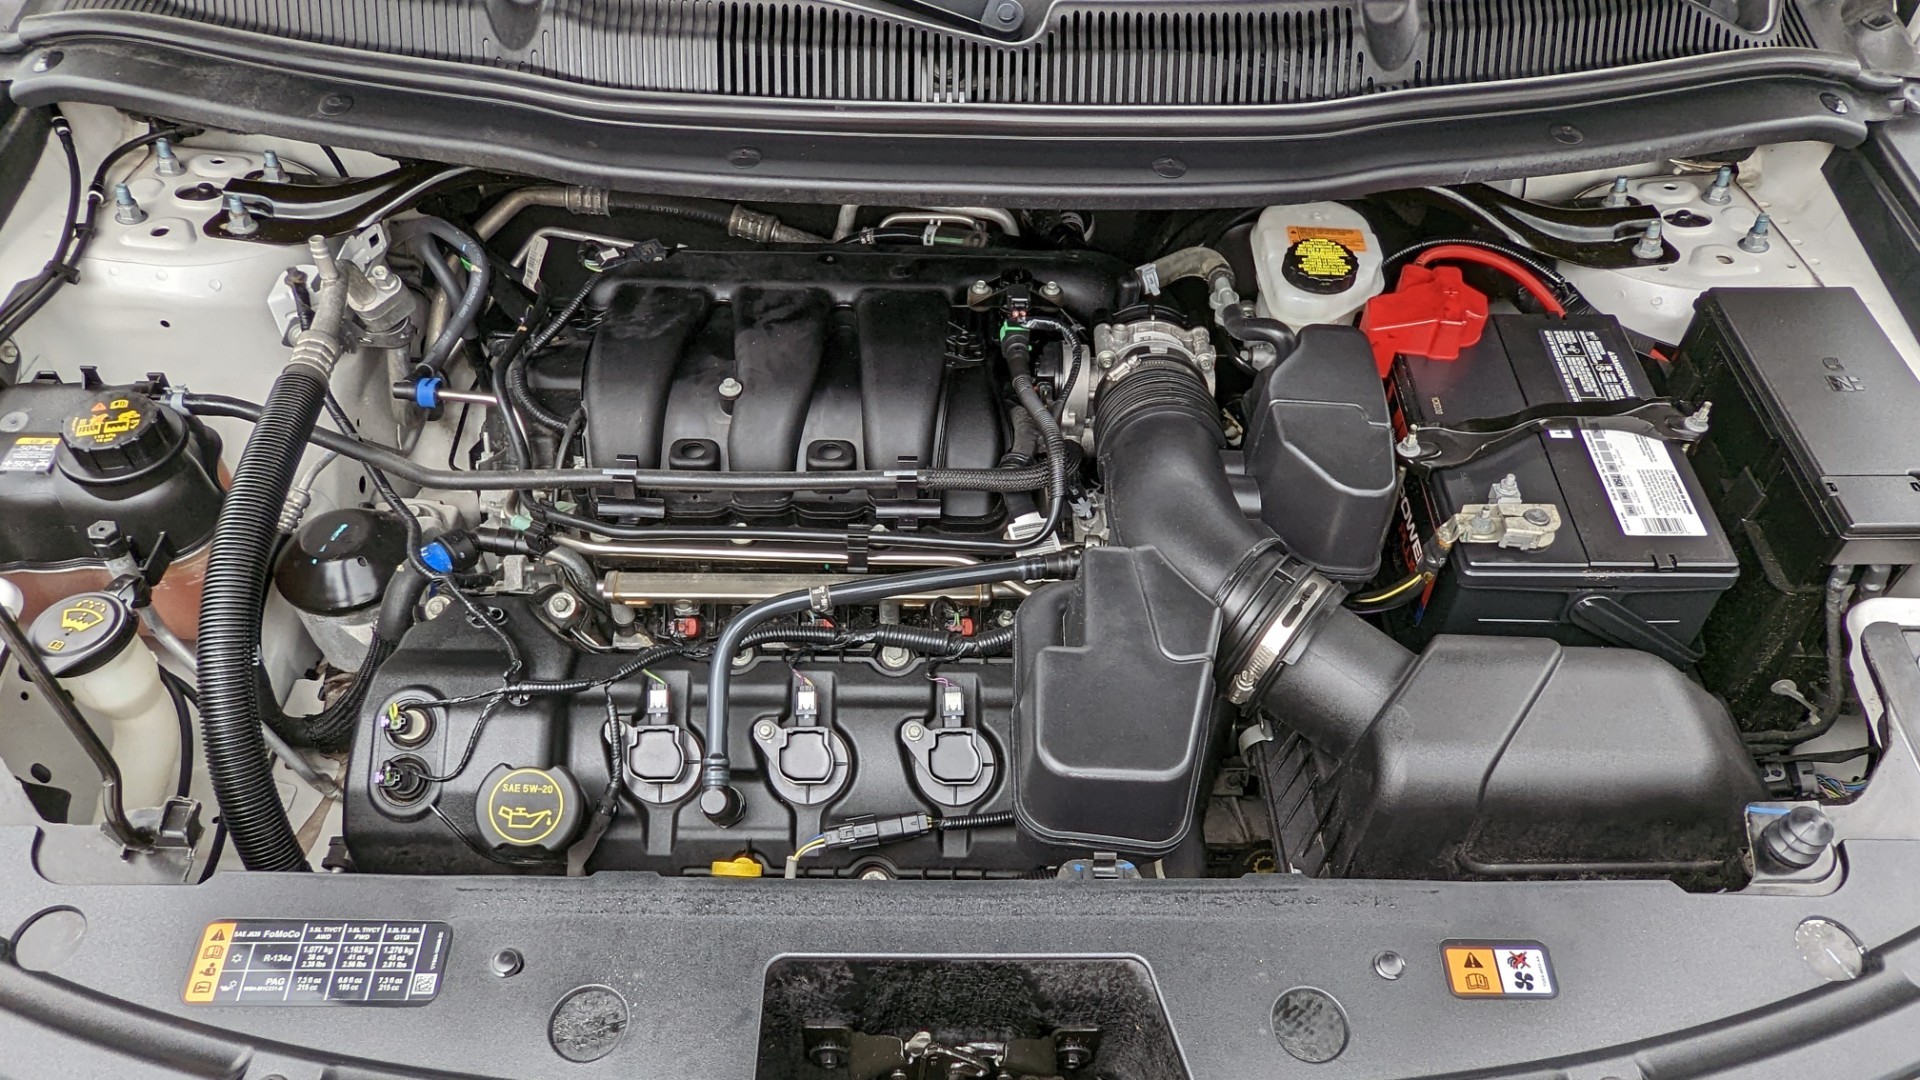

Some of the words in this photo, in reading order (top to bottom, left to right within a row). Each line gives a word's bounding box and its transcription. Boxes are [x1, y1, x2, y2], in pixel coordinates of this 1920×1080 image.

[1611, 475, 1624, 487] 750
[1399, 483, 1423, 565] POWE
[502, 783, 521, 793] SAE
[522, 784, 554, 794] 5W-20
[263, 930, 301, 939] FoMoCo
[302, 945, 324, 954] 1.077
[322, 945, 335, 956] kg
[363, 945, 375, 956] kg
[403, 946, 415, 956] kg
[262, 953, 293, 962] R-134a
[264, 977, 286, 986] PAG
